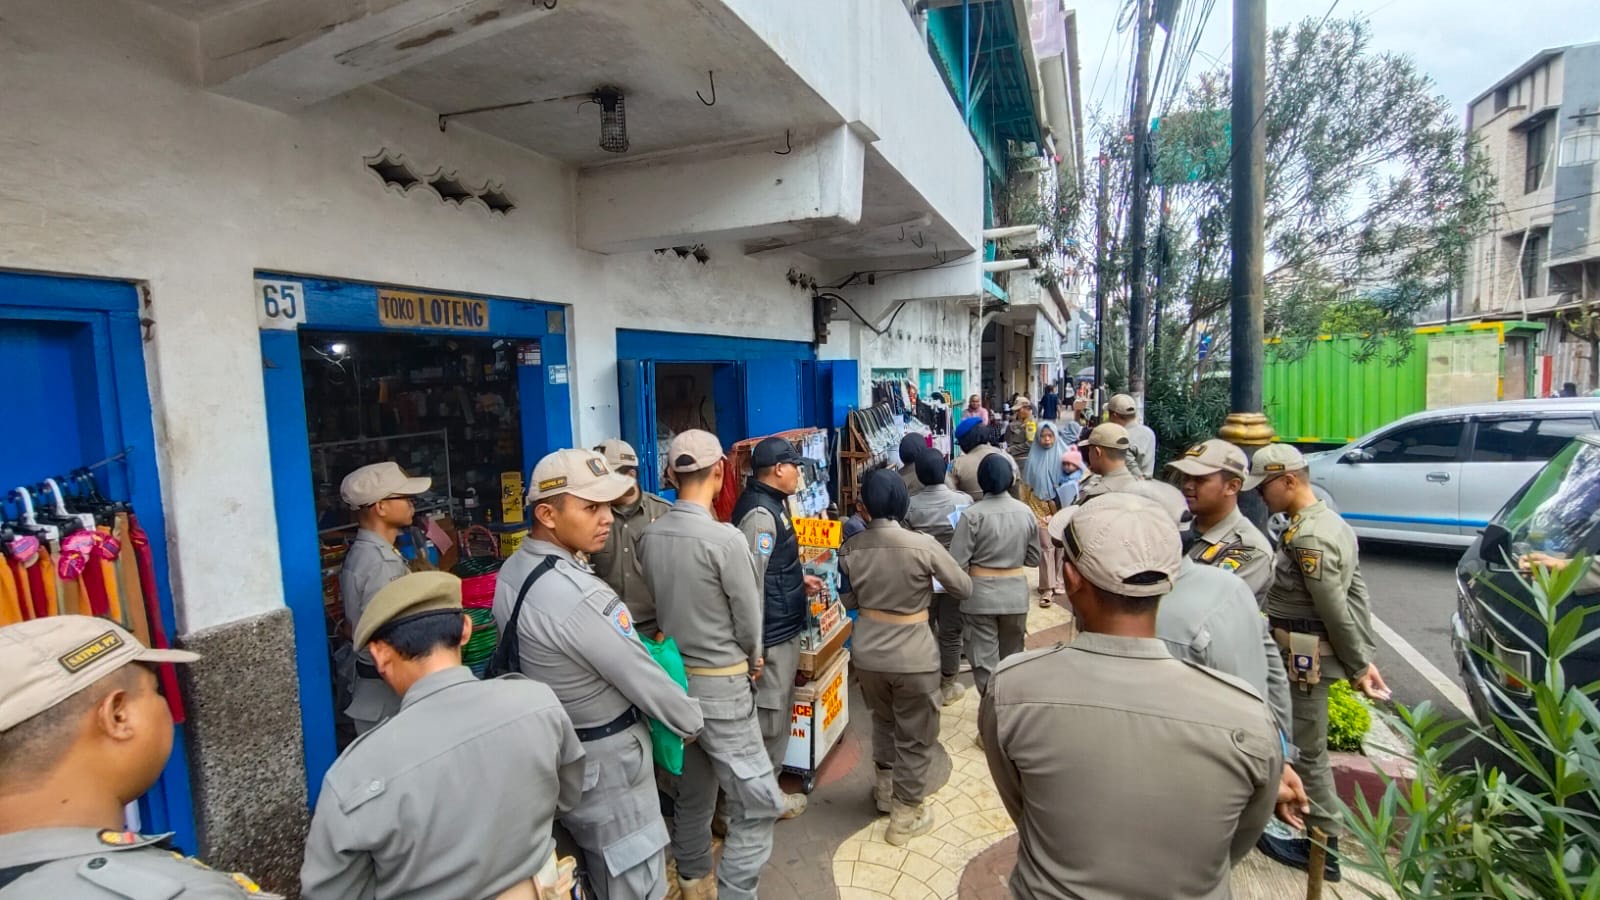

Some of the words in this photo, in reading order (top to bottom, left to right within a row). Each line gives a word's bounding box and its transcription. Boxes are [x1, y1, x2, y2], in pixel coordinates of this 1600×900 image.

[262, 284, 296, 319] 65
[381, 296, 414, 321] TOKO
[419, 297, 484, 327] LOTENG
[68, 643, 105, 666] SATPOL
[102, 635, 115, 647] PP
